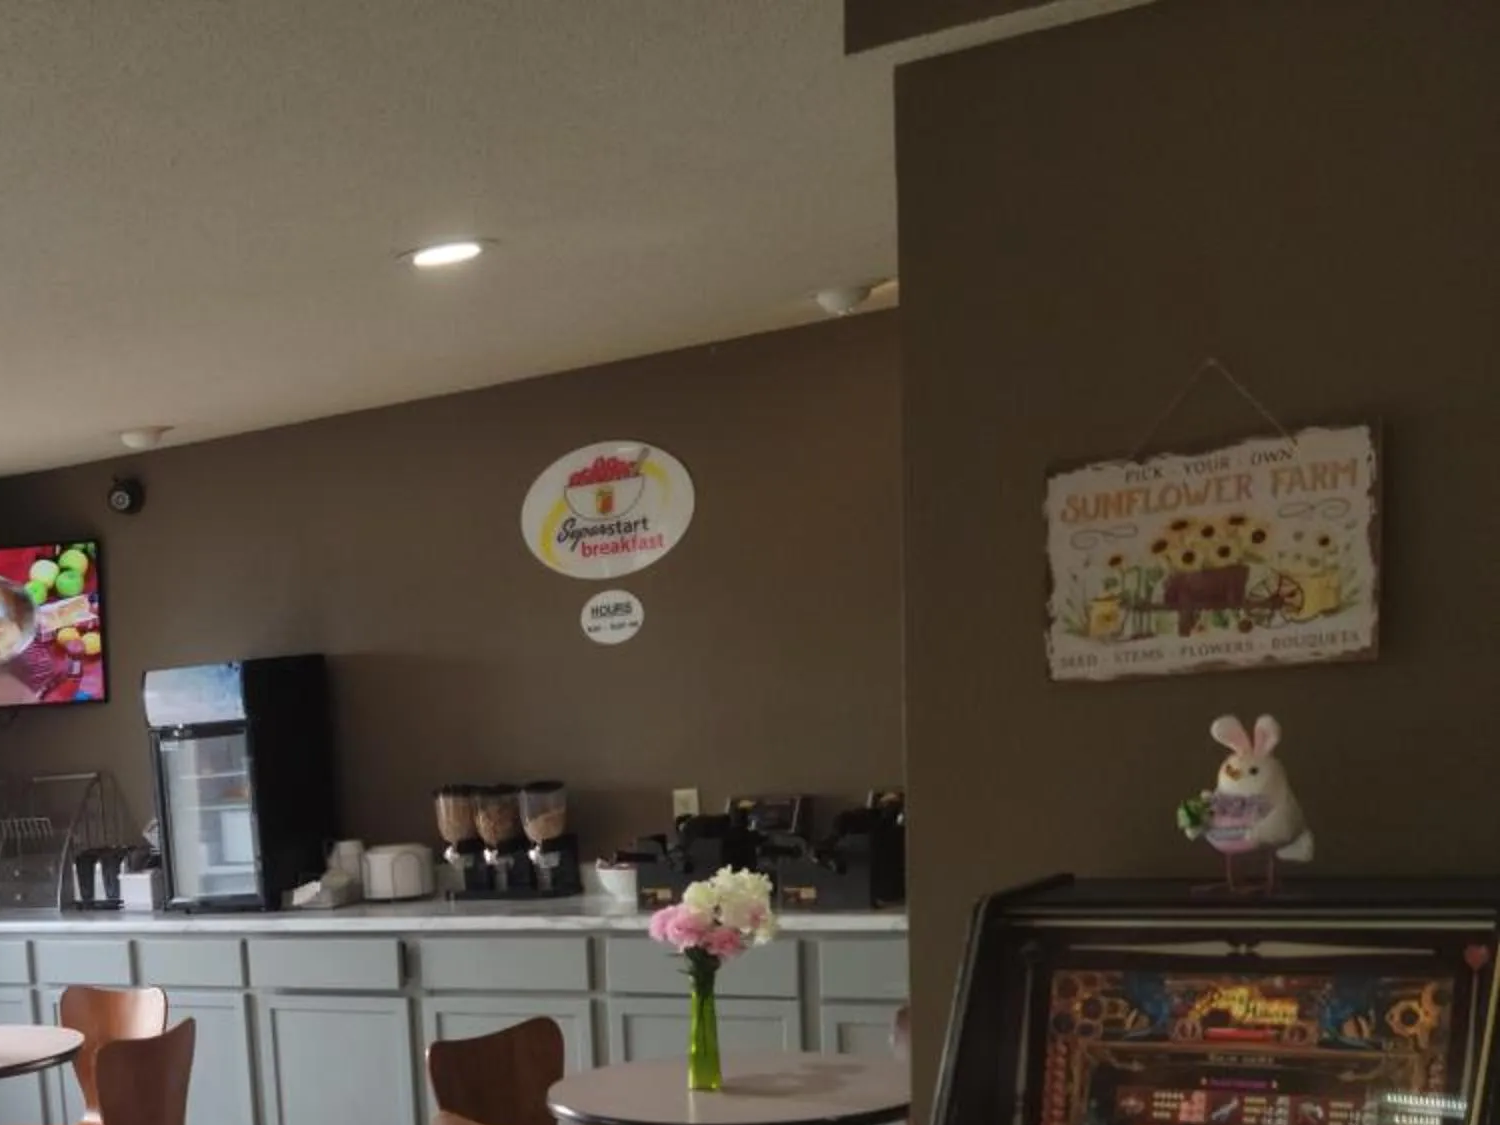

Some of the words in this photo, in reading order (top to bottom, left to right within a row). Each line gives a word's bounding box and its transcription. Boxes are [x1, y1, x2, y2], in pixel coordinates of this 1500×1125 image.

[1124, 465, 1163, 482] PICK
[1183, 457, 1231, 476] YOUR
[1251, 446, 1295, 466] OWN
[1060, 473, 1254, 524] SUNFLOWER
[1270, 458, 1359, 498] FARM
[581, 533, 665, 558] breakfast
[590, 602, 633, 618] HOURS
[1113, 647, 1164, 664] STEMS
[1180, 640, 1254, 658] FLOWERS
[1271, 631, 1360, 649] BOUQUETS
